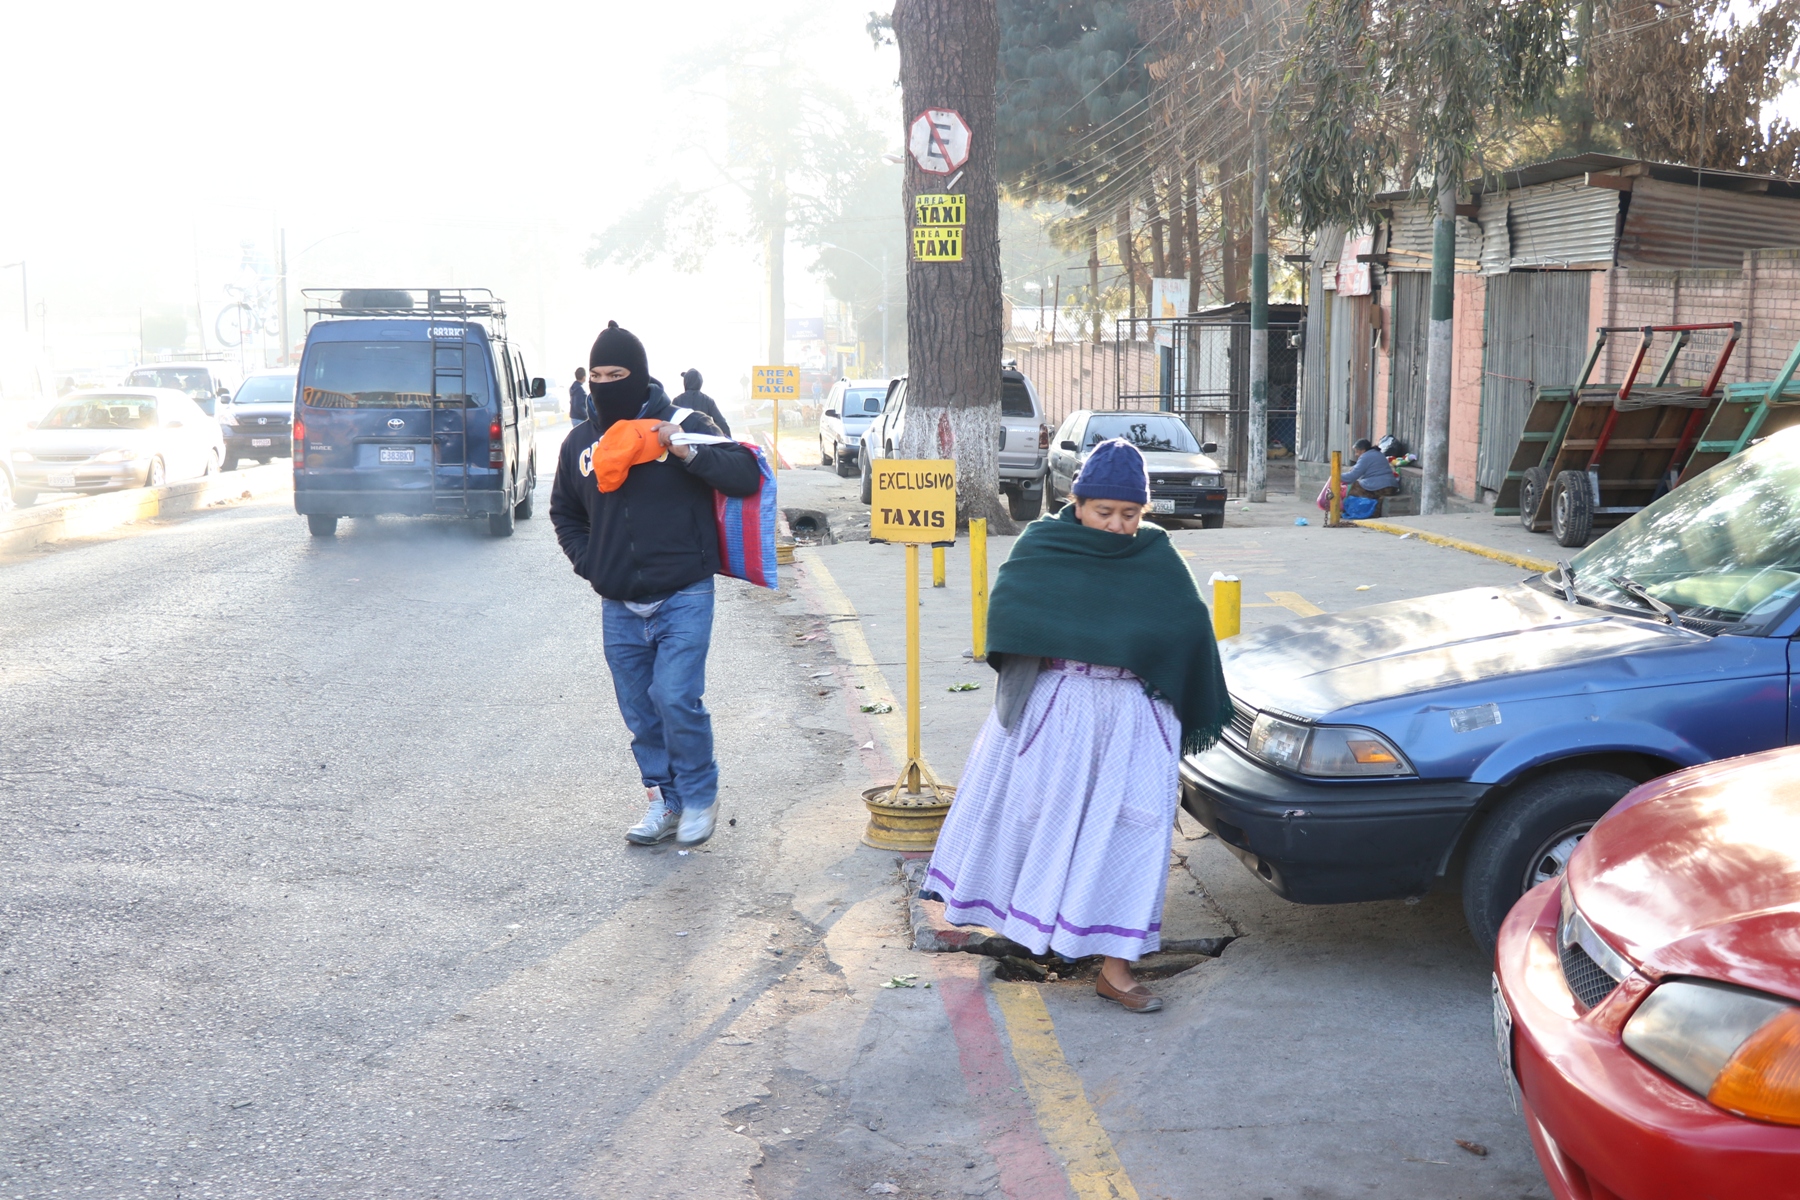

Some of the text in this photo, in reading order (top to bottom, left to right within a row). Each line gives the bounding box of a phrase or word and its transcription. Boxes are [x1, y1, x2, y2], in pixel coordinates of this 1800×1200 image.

[927, 123, 951, 158] E
[917, 196, 964, 205] AREA DE
[920, 206, 961, 223] TAXI
[915, 230, 960, 238] AREA DE
[917, 239, 957, 256] TAXI
[757, 369, 794, 377] AREA
[766, 377, 784, 385] DE
[757, 385, 794, 393] TAXIS
[381, 451, 413, 461] C383BKV
[879, 472, 953, 491] EXCLUSIVO
[881, 508, 945, 528] TAXIS
